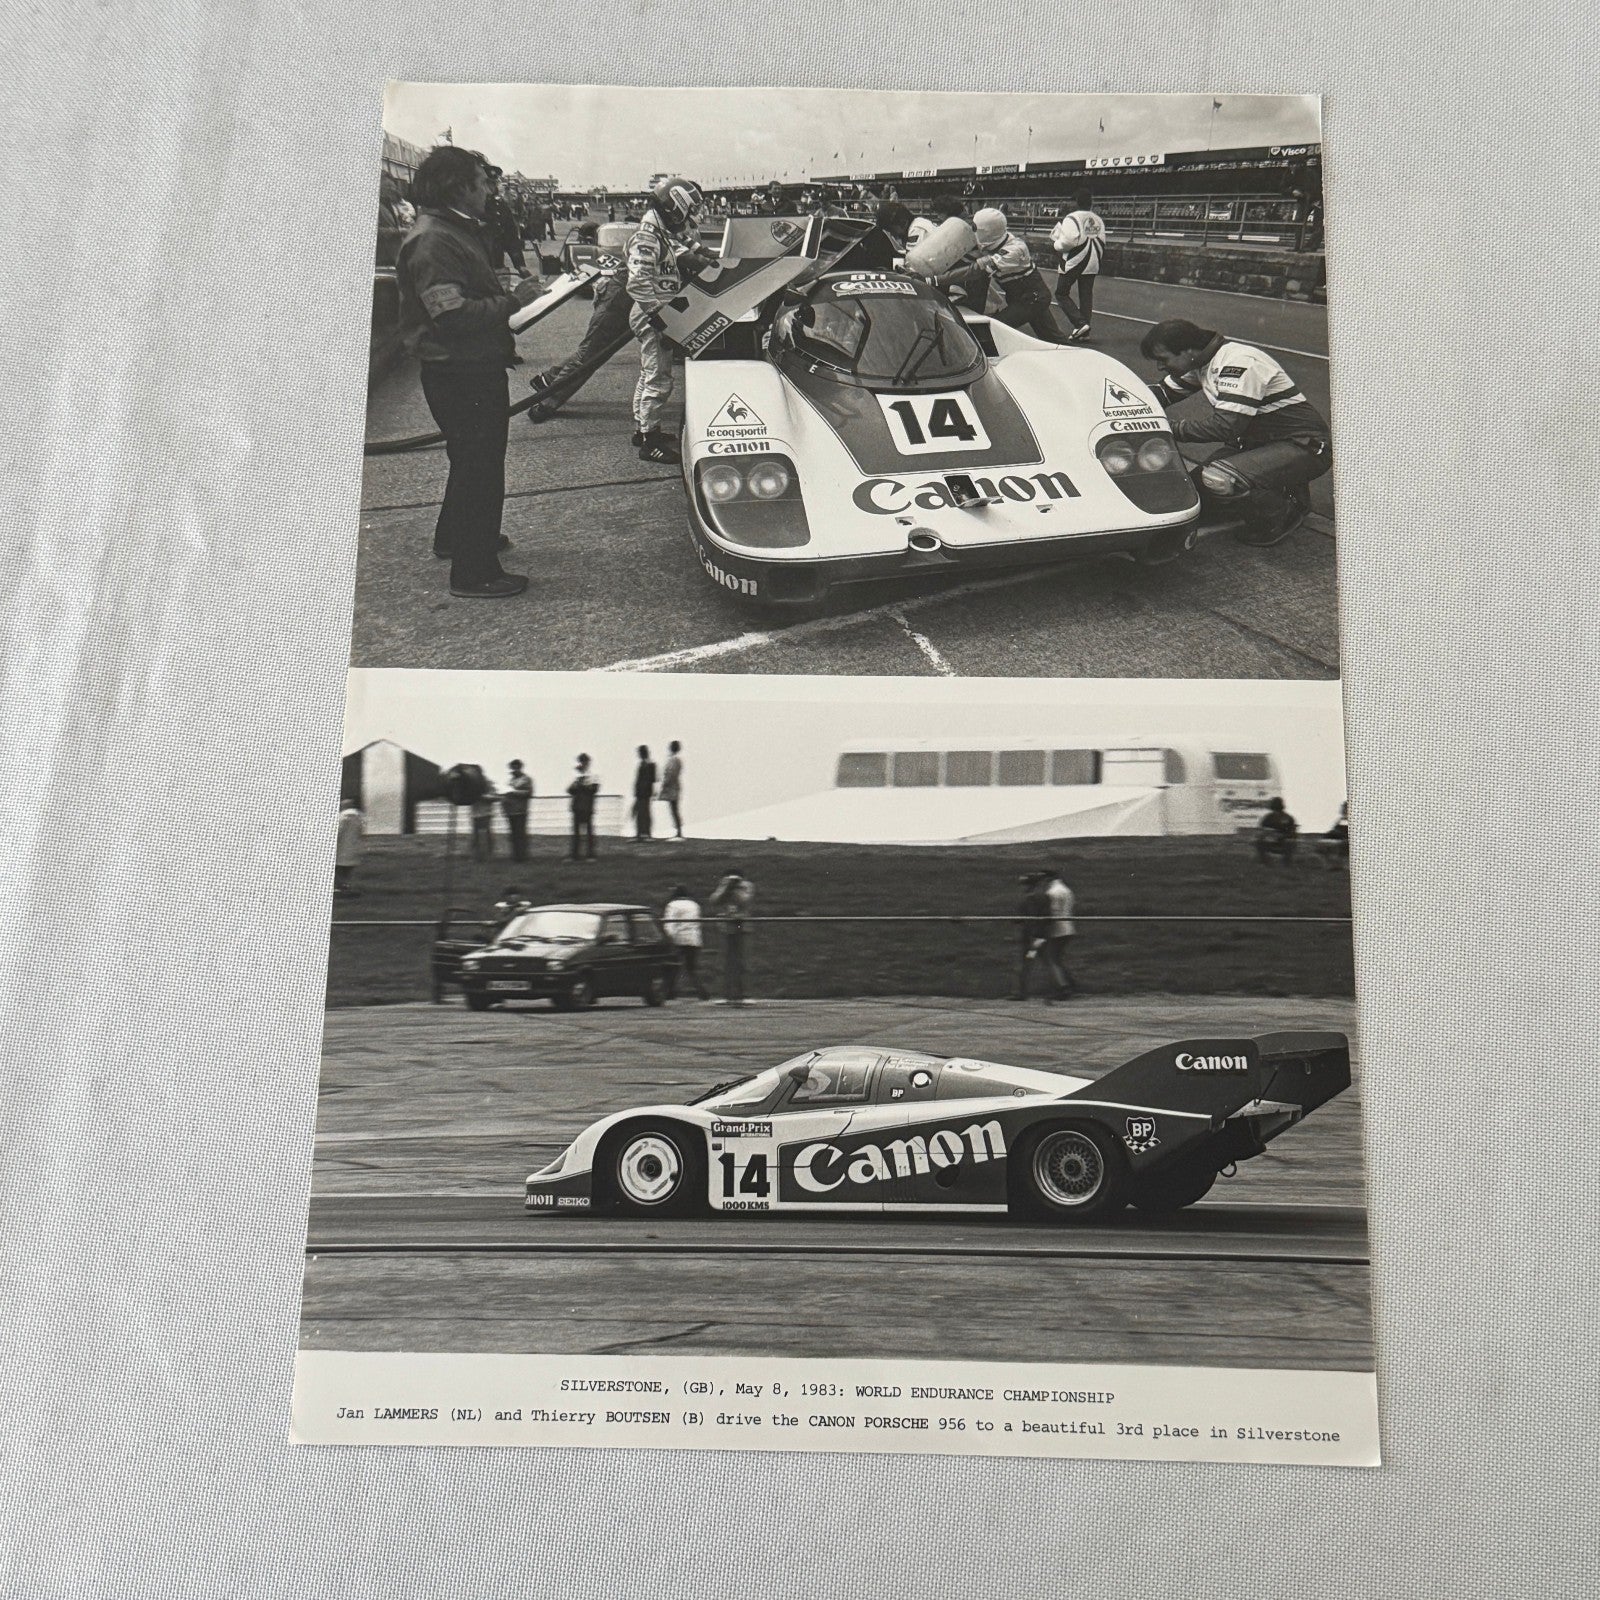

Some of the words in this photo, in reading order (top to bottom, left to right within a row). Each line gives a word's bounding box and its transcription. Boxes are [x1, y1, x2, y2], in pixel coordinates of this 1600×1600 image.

[599, 254, 620, 268] 35
[831, 281, 916, 295] Canon
[695, 316, 729, 344] Grand
[889, 399, 978, 445] 14
[1110, 420, 1160, 432] Canon
[706, 427, 715, 437] le
[707, 441, 770, 454] Canon
[699, 544, 758, 596] Canon
[1175, 1053, 1248, 1071] Canon
[891, 1088, 904, 1097] BP
[713, 1122, 746, 1133] Grand
[748, 1122, 770, 1133] Prix
[1131, 1122, 1152, 1137] BP
[793, 1119, 1007, 1192] Canon
[718, 1152, 771, 1197] 14
[525, 1194, 554, 1205] anon
[557, 1197, 591, 1206] SEIKO
[722, 1201, 747, 1210] 1000
[747, 1201, 770, 1210] KMS
[560, 1379, 670, 1397] SILVERSTONE,
[683, 1380, 725, 1397] (GB),
[735, 1382, 764, 1398] May
[772, 1382, 789, 1398] 8,
[801, 1383, 844, 1397] 1983:
[855, 1385, 902, 1398] WORLD
[910, 1386, 994, 1401] ENDURANCE
[1002, 1389, 1115, 1404] CHAMPIONSHIP
[336, 1407, 365, 1420] Jan
[373, 1407, 439, 1421] LAMMERS
[451, 1407, 482, 1423] (NL)
[494, 1408, 523, 1422] and
[530, 1409, 597, 1426] Thierry
[605, 1410, 671, 1424] BOUTSEN
[682, 1411, 704, 1426] (B)
[715, 1412, 762, 1426] drive
[771, 1413, 799, 1427] the
[808, 1414, 856, 1428] CANON
[863, 1416, 929, 1430] PORSCHE
[938, 1417, 967, 1432] 956
[975, 1419, 995, 1432] to
[1003, 1422, 1014, 1433] a
[1021, 1419, 1106, 1435] beautiful
[1116, 1422, 1144, 1436] 3rd
[1152, 1423, 1200, 1440] place
[1209, 1425, 1228, 1439] in
[1236, 1426, 1341, 1443] Silverstone
